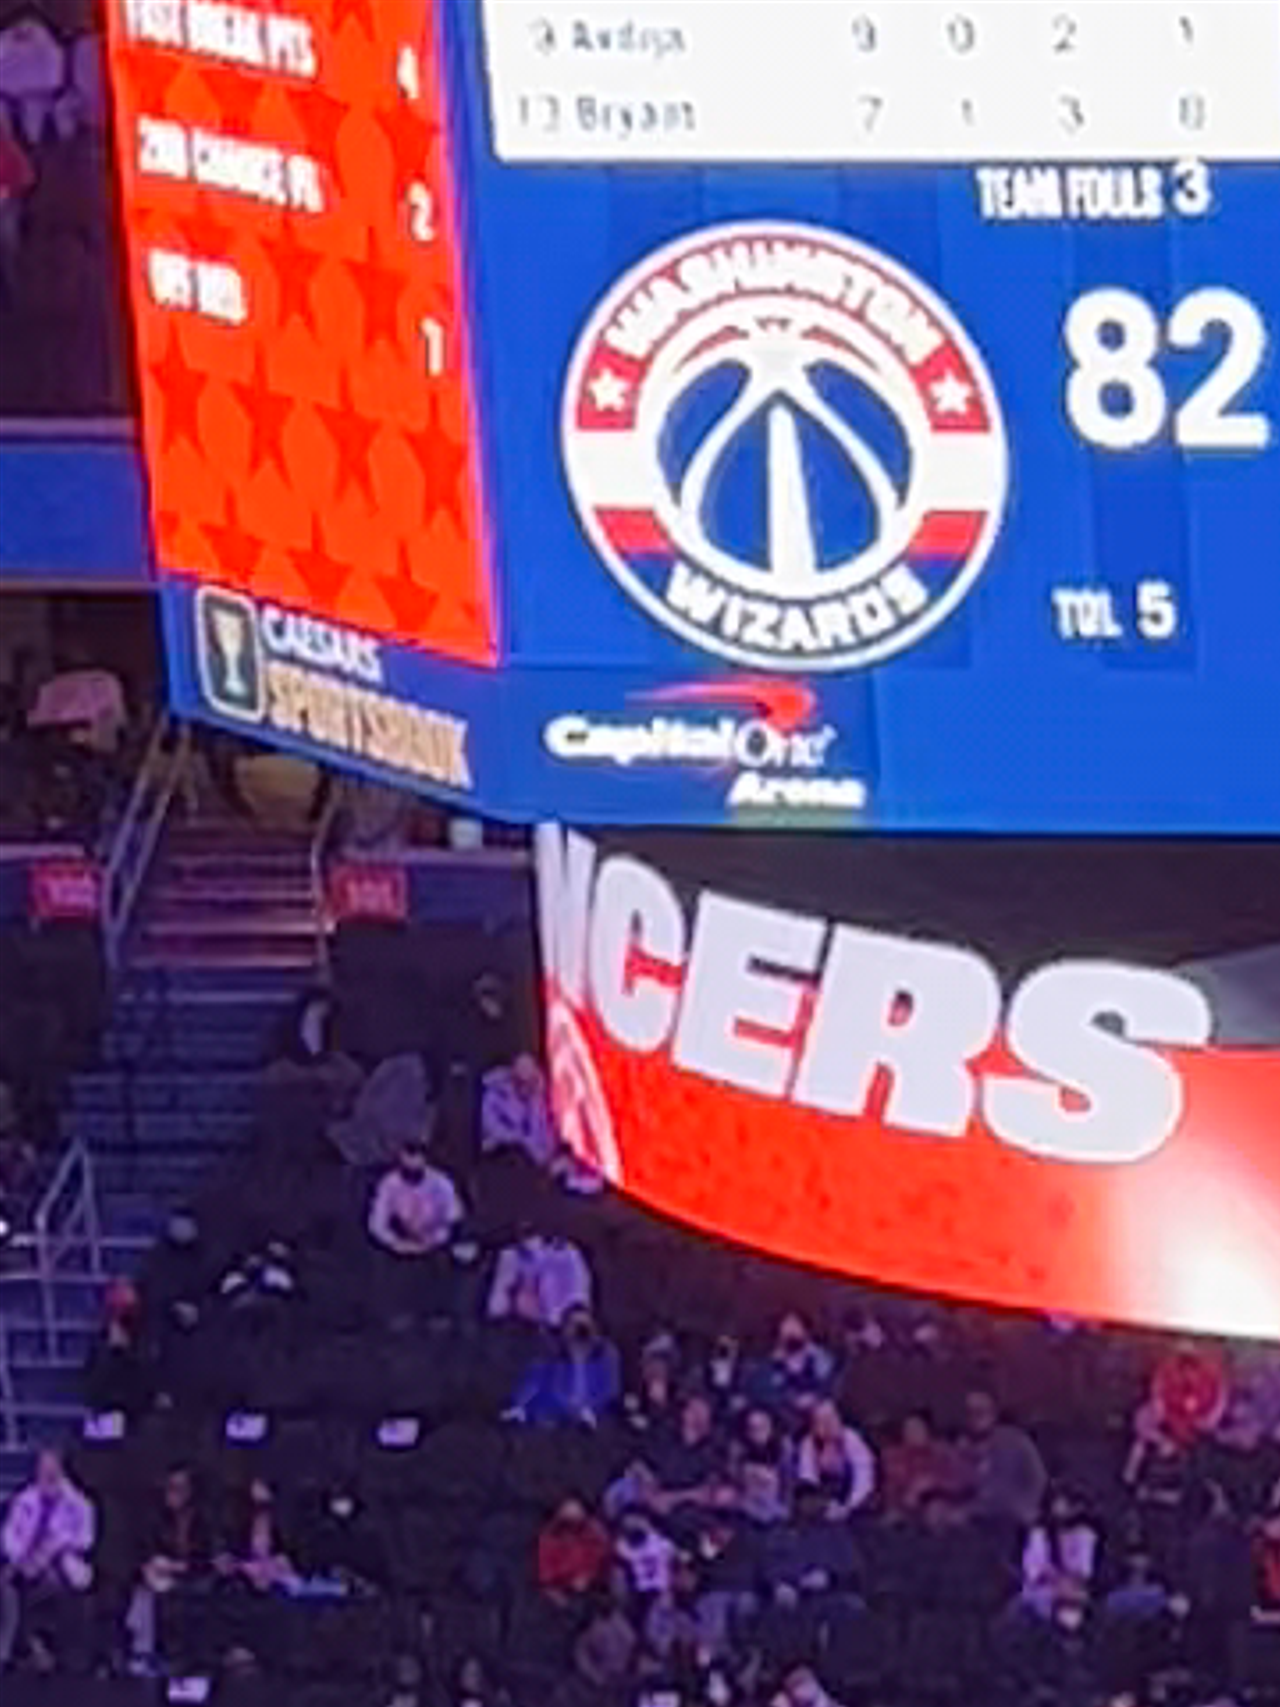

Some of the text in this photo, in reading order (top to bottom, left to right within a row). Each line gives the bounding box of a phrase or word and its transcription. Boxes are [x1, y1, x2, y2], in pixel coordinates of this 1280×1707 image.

[1050, 15, 1077, 54] 2
[1058, 96, 1085, 130] 3
[404, 180, 434, 242] 2
[974, 165, 1066, 220] TEAM
[1172, 158, 1212, 216] 3
[601, 240, 945, 368] WASHINGTON
[419, 316, 446, 377] 1
[1062, 287, 1272, 451] 82
[664, 562, 930, 652] WIZARDS
[1051, 583, 1177, 638] TOL 5
[266, 666, 473, 789] SPORTSBOOK
[543, 712, 834, 768] Capital One
[726, 771, 867, 811] Arena
